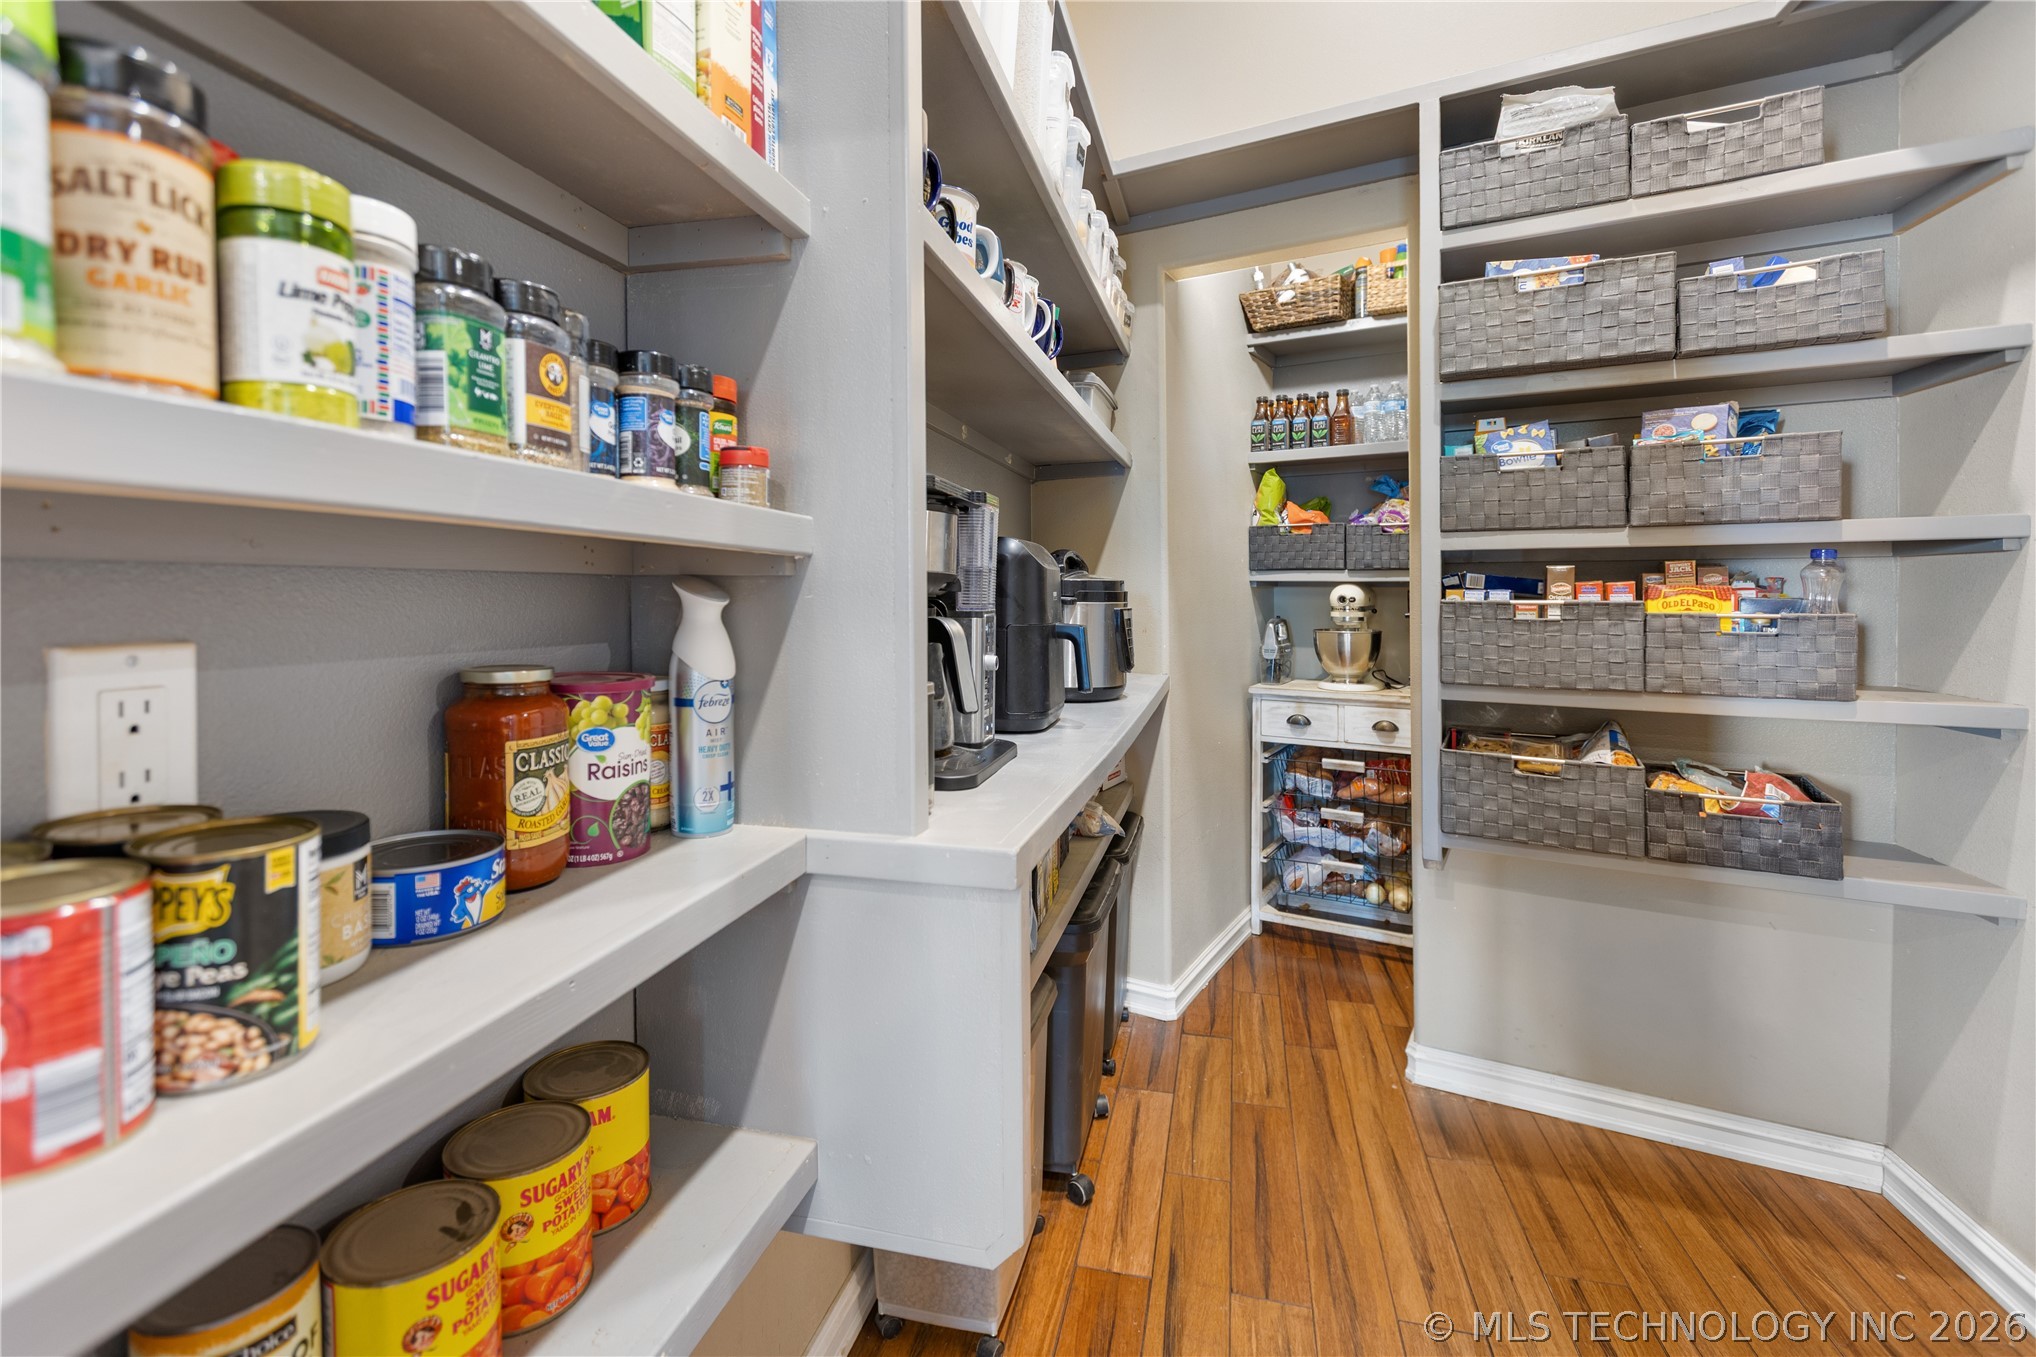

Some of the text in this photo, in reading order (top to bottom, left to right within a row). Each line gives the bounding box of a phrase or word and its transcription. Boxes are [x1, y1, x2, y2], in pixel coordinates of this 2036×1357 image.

[50, 165, 135, 199] SALT
[53, 230, 139, 264] DRY
[85, 267, 192, 307] GARLIC
[278, 279, 327, 305] Lime
[468, 348, 501, 367] CILANTRO
[477, 361, 495, 373] LIME
[1661, 600, 1679, 610] OLD
[1680, 598, 1691, 606] EL
[698, 693, 731, 710] febreze
[581, 732, 609, 742] Great
[705, 727, 727, 737] AIR
[698, 744, 718, 754] HEAVY
[587, 758, 648, 781] Raisins
[514, 787, 542, 804] REAL
[702, 790, 714, 802] 2X
[517, 814, 555, 829] ROASTED
[185, 961, 249, 988] Peas
[520, 1160, 583, 1208] SUGARY
[554, 1180, 588, 1215] SWEET
